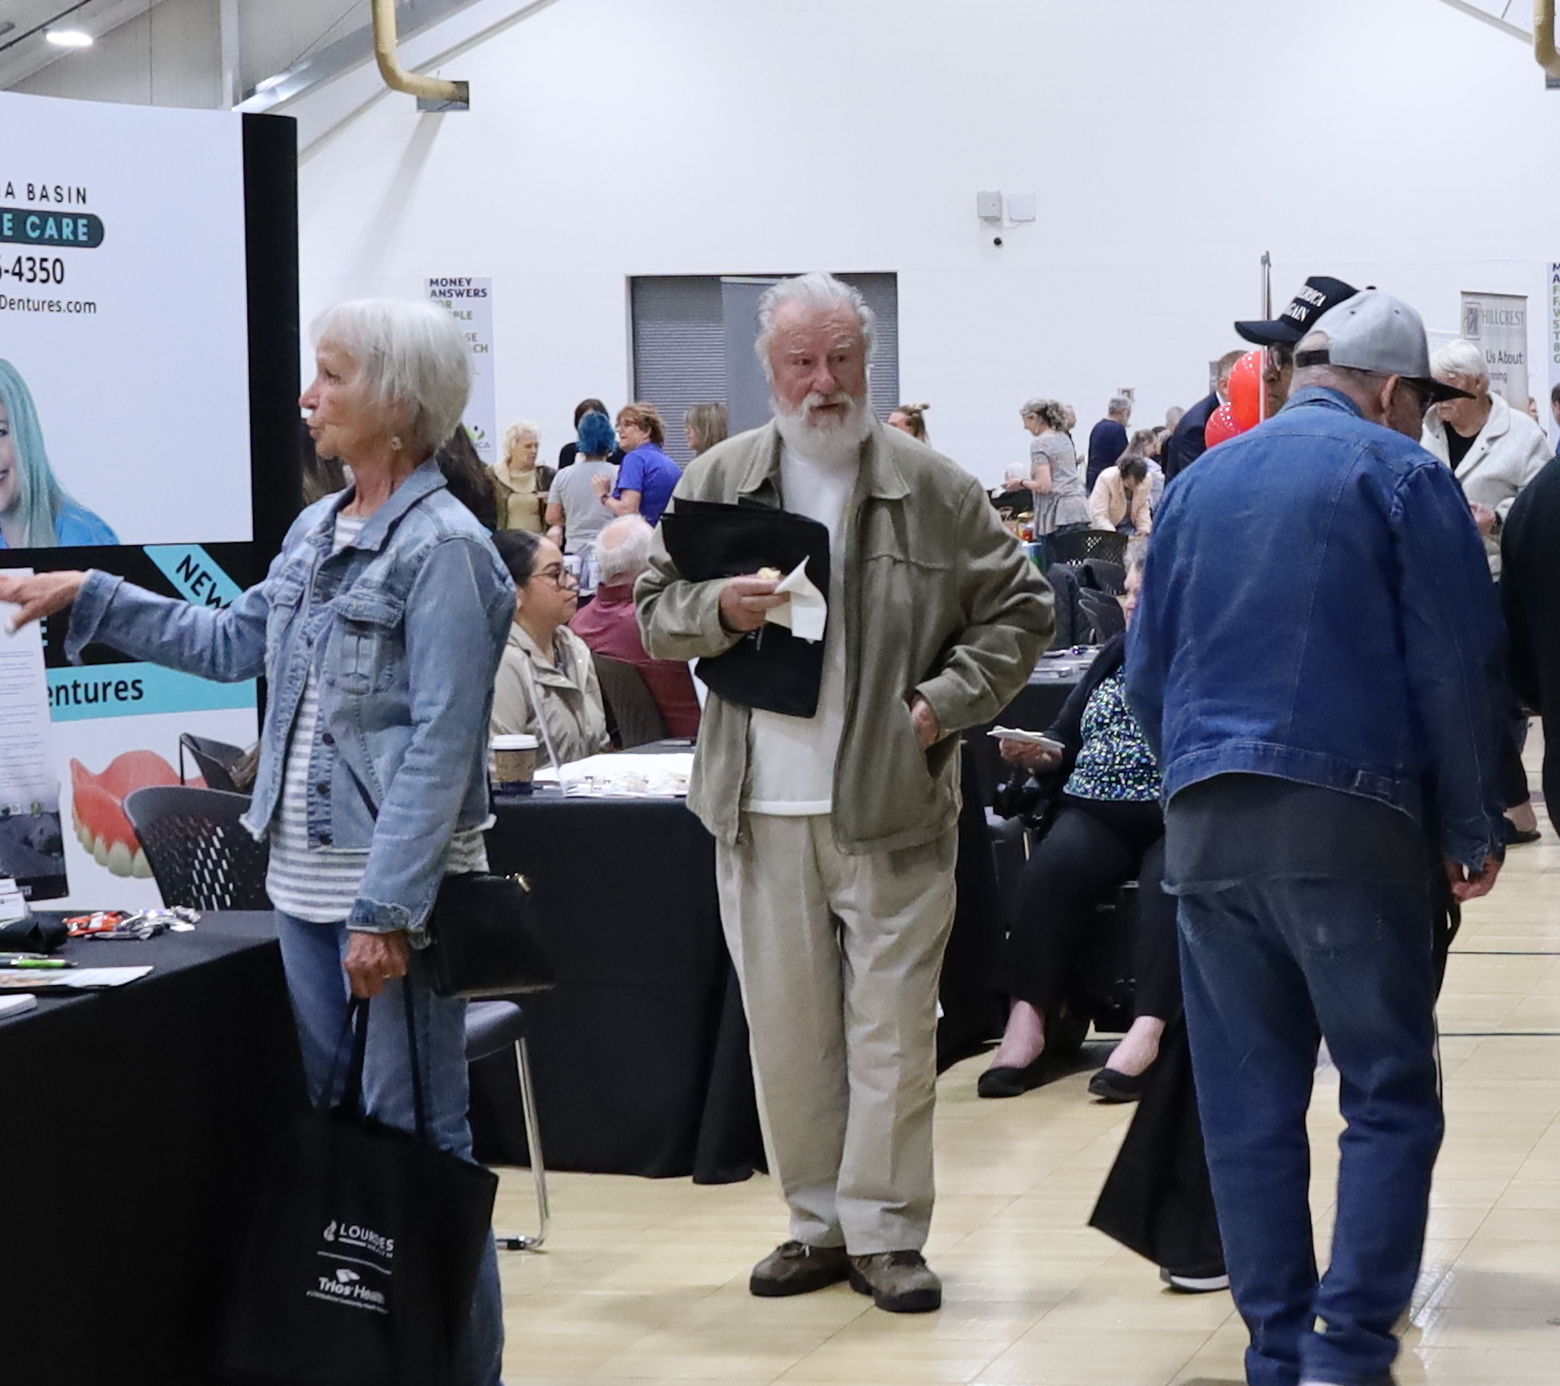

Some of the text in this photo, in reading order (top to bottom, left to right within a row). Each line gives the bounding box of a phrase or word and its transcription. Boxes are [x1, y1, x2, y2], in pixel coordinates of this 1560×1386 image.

[26, 183, 87, 205] BASIN
[26, 215, 88, 241] CARE
[429, 278, 472, 287] MONEY
[430, 288, 487, 298] ANSWERS
[1481, 309, 1524, 326] HILLCREST
[1553, 342, 1560, 352] 8
[1486, 349, 1496, 364] Us
